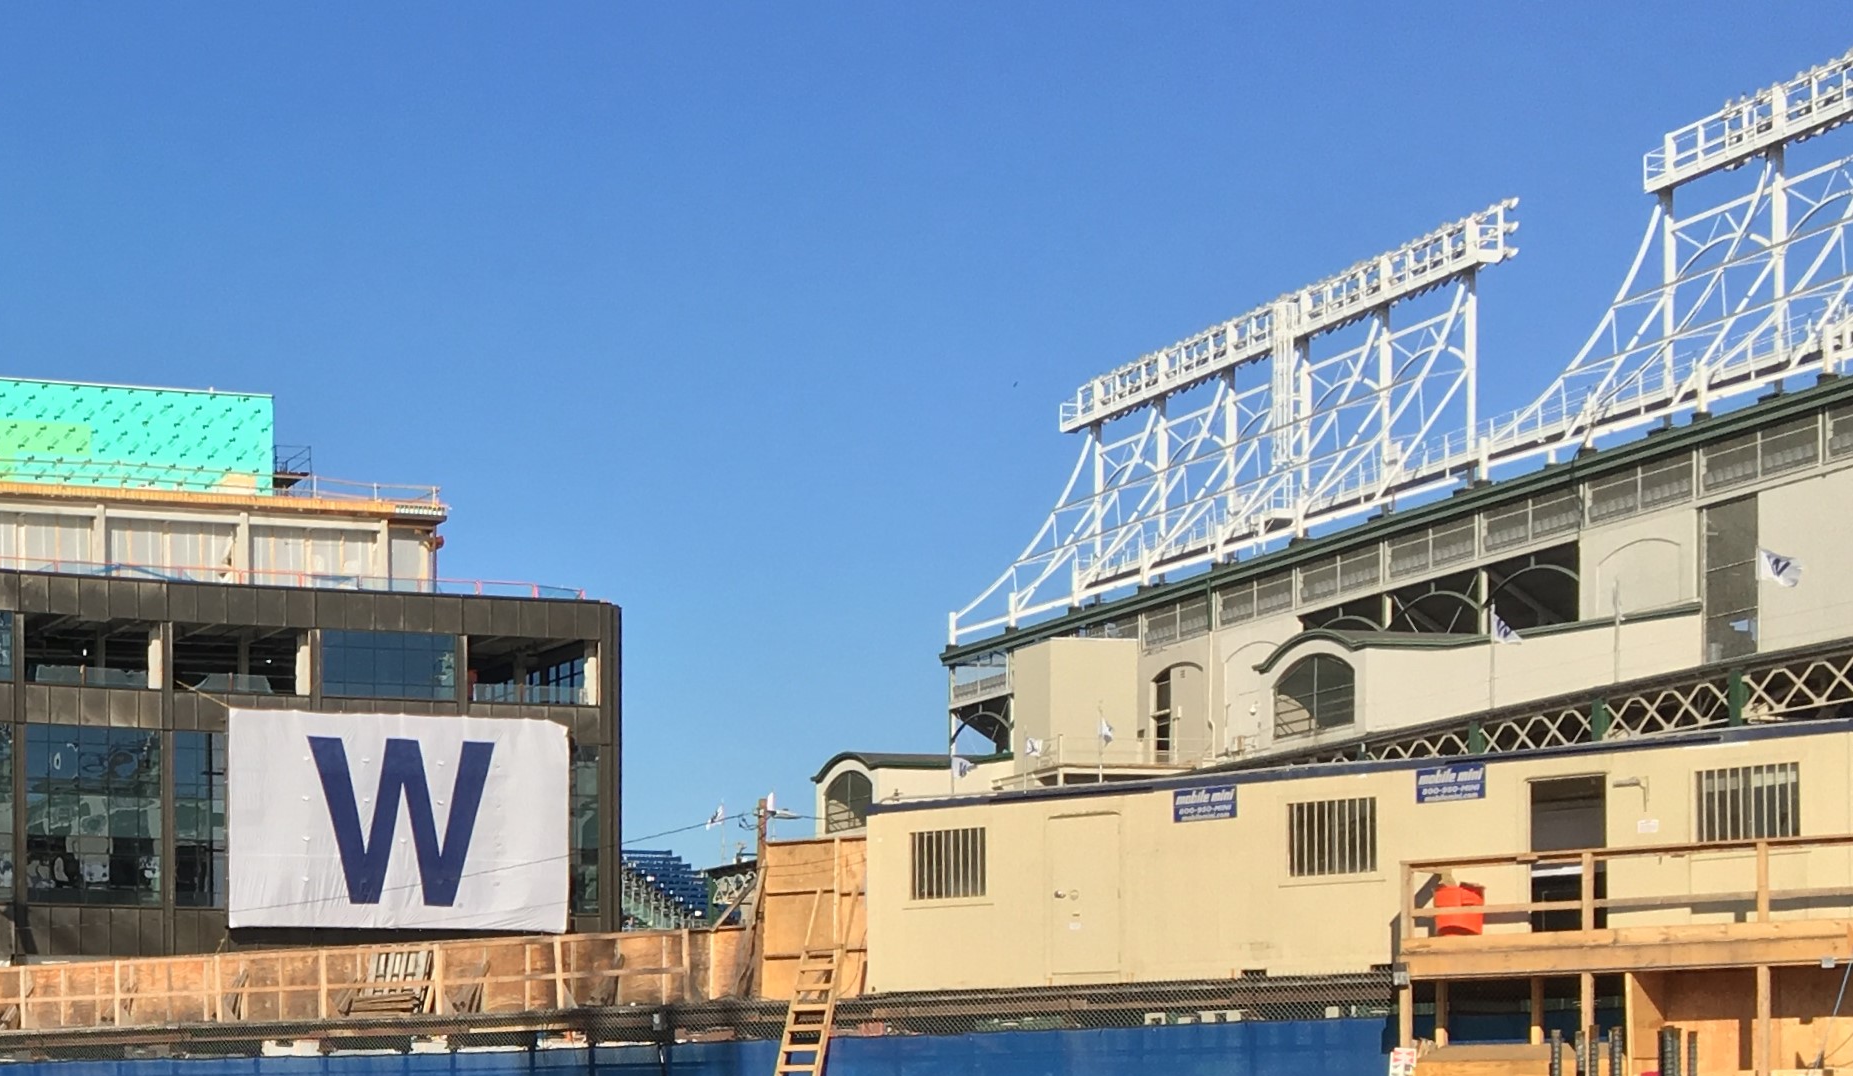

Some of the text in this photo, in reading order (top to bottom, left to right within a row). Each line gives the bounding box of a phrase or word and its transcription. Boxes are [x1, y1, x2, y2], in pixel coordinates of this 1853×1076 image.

[1418, 767, 1484, 785] mobile mini
[1175, 788, 1235, 805] mobile mini
[307, 735, 495, 907] W
